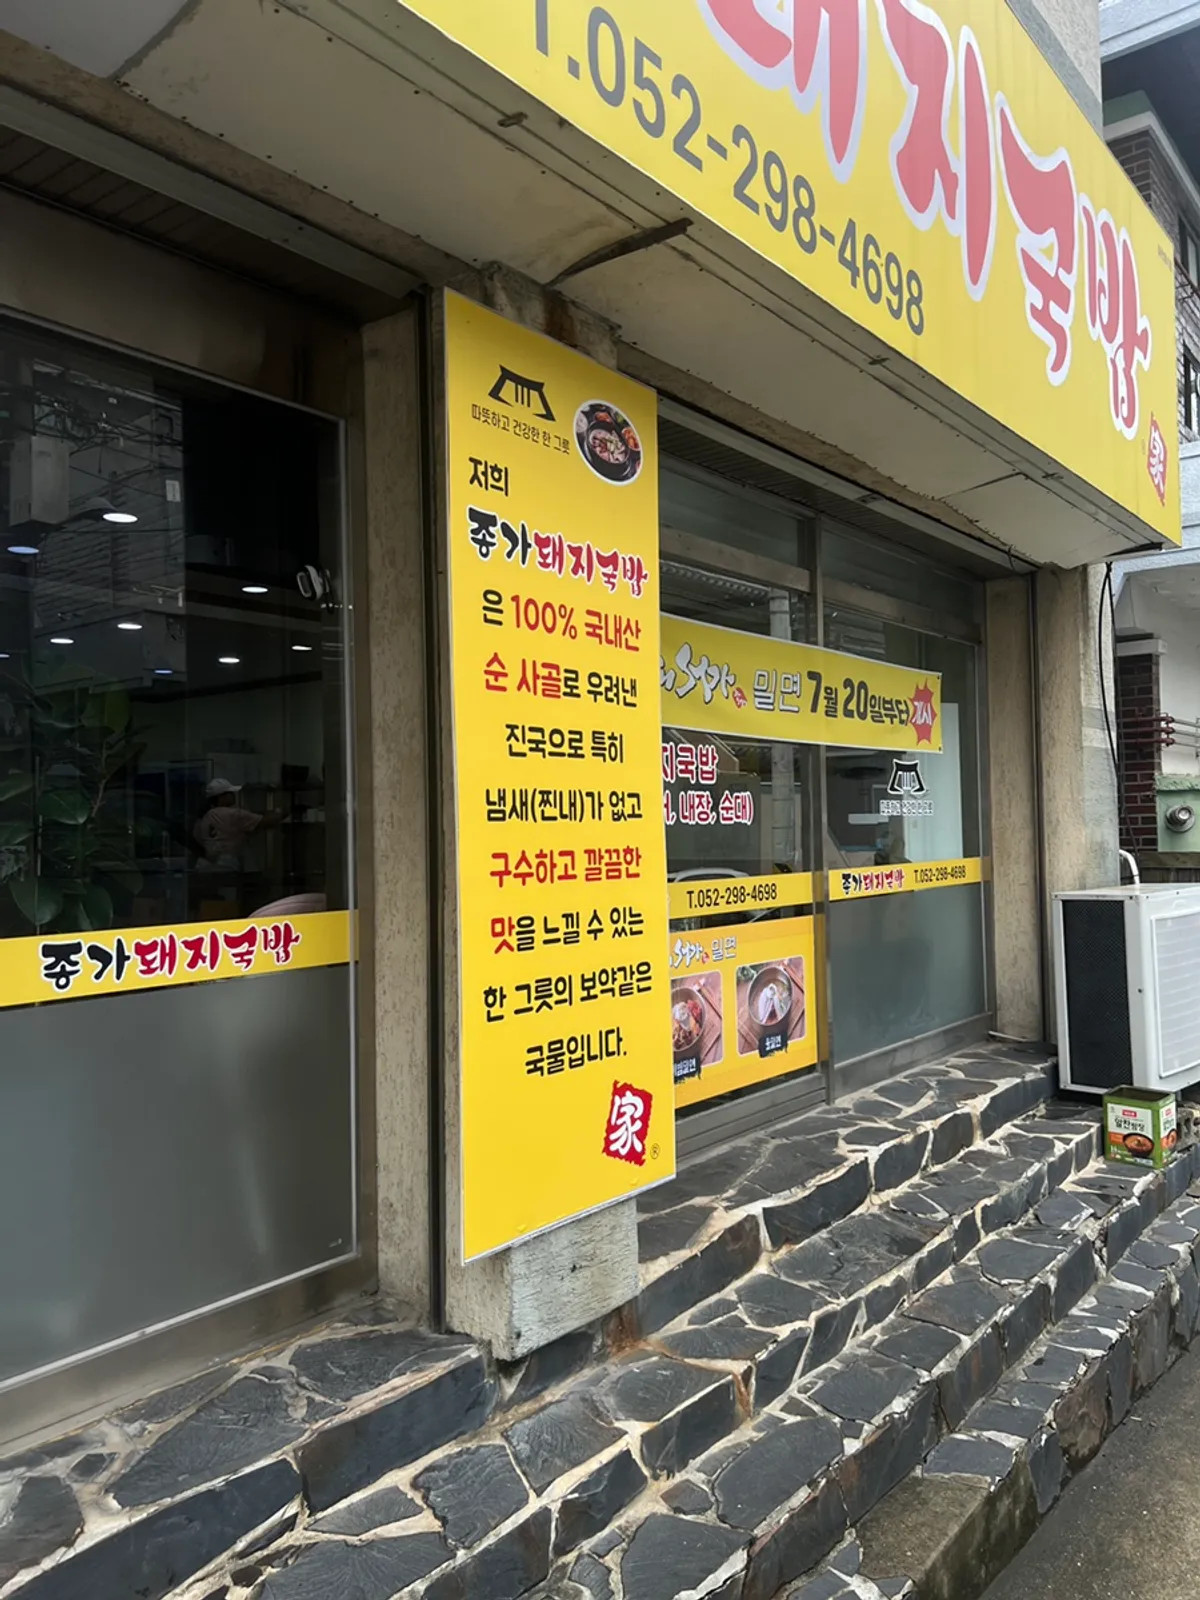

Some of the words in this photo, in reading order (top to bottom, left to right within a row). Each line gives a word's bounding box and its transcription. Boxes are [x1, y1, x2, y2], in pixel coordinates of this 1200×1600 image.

[471, 403, 510, 432] 따뜻하고
[512, 419, 540, 444] 건강한
[542, 431, 551, 448] 한
[553, 434, 570, 456] 그릇
[468, 456, 509, 496] 저희
[467, 506, 648, 597] 종가돼지국밥
[482, 589, 504, 626] 은
[510, 594, 578, 640] 100%
[584, 608, 642, 652] 국내산
[483, 652, 509, 692] 순
[517, 658, 581, 699] 사골로
[587, 671, 637, 708] 우려낸
[753, 669, 802, 714] 밀면
[807, 670, 839, 718] 7월
[843, 678, 910, 726] 20일부터
[505, 723, 586, 759] 진국으로
[590, 730, 624, 764] 특히
[485, 787, 604, 823] 냄새(찐내)가
[608, 790, 643, 822] 없고
[679, 791, 717, 825] 내장,
[719, 790, 754, 825] 순대)
[490, 849, 578, 888] 구수하고
[584, 845, 642, 882] 깔끔한
[913, 865, 967, 884] T.052-298-4698
[686, 883, 778, 910] T.052-298-4698
[490, 914, 536, 954] 맛을
[542, 911, 580, 945] 느낄
[587, 908, 605, 941] 수
[609, 906, 644, 939] 있는
[39, 920, 302, 992] 종가돼지국밥
[483, 985, 507, 1023] 한
[513, 974, 573, 1015] 그릇의
[580, 961, 652, 1002] 보약같은
[525, 1026, 627, 1077] 국물입니다.
[609, 1090, 644, 1155] 家
